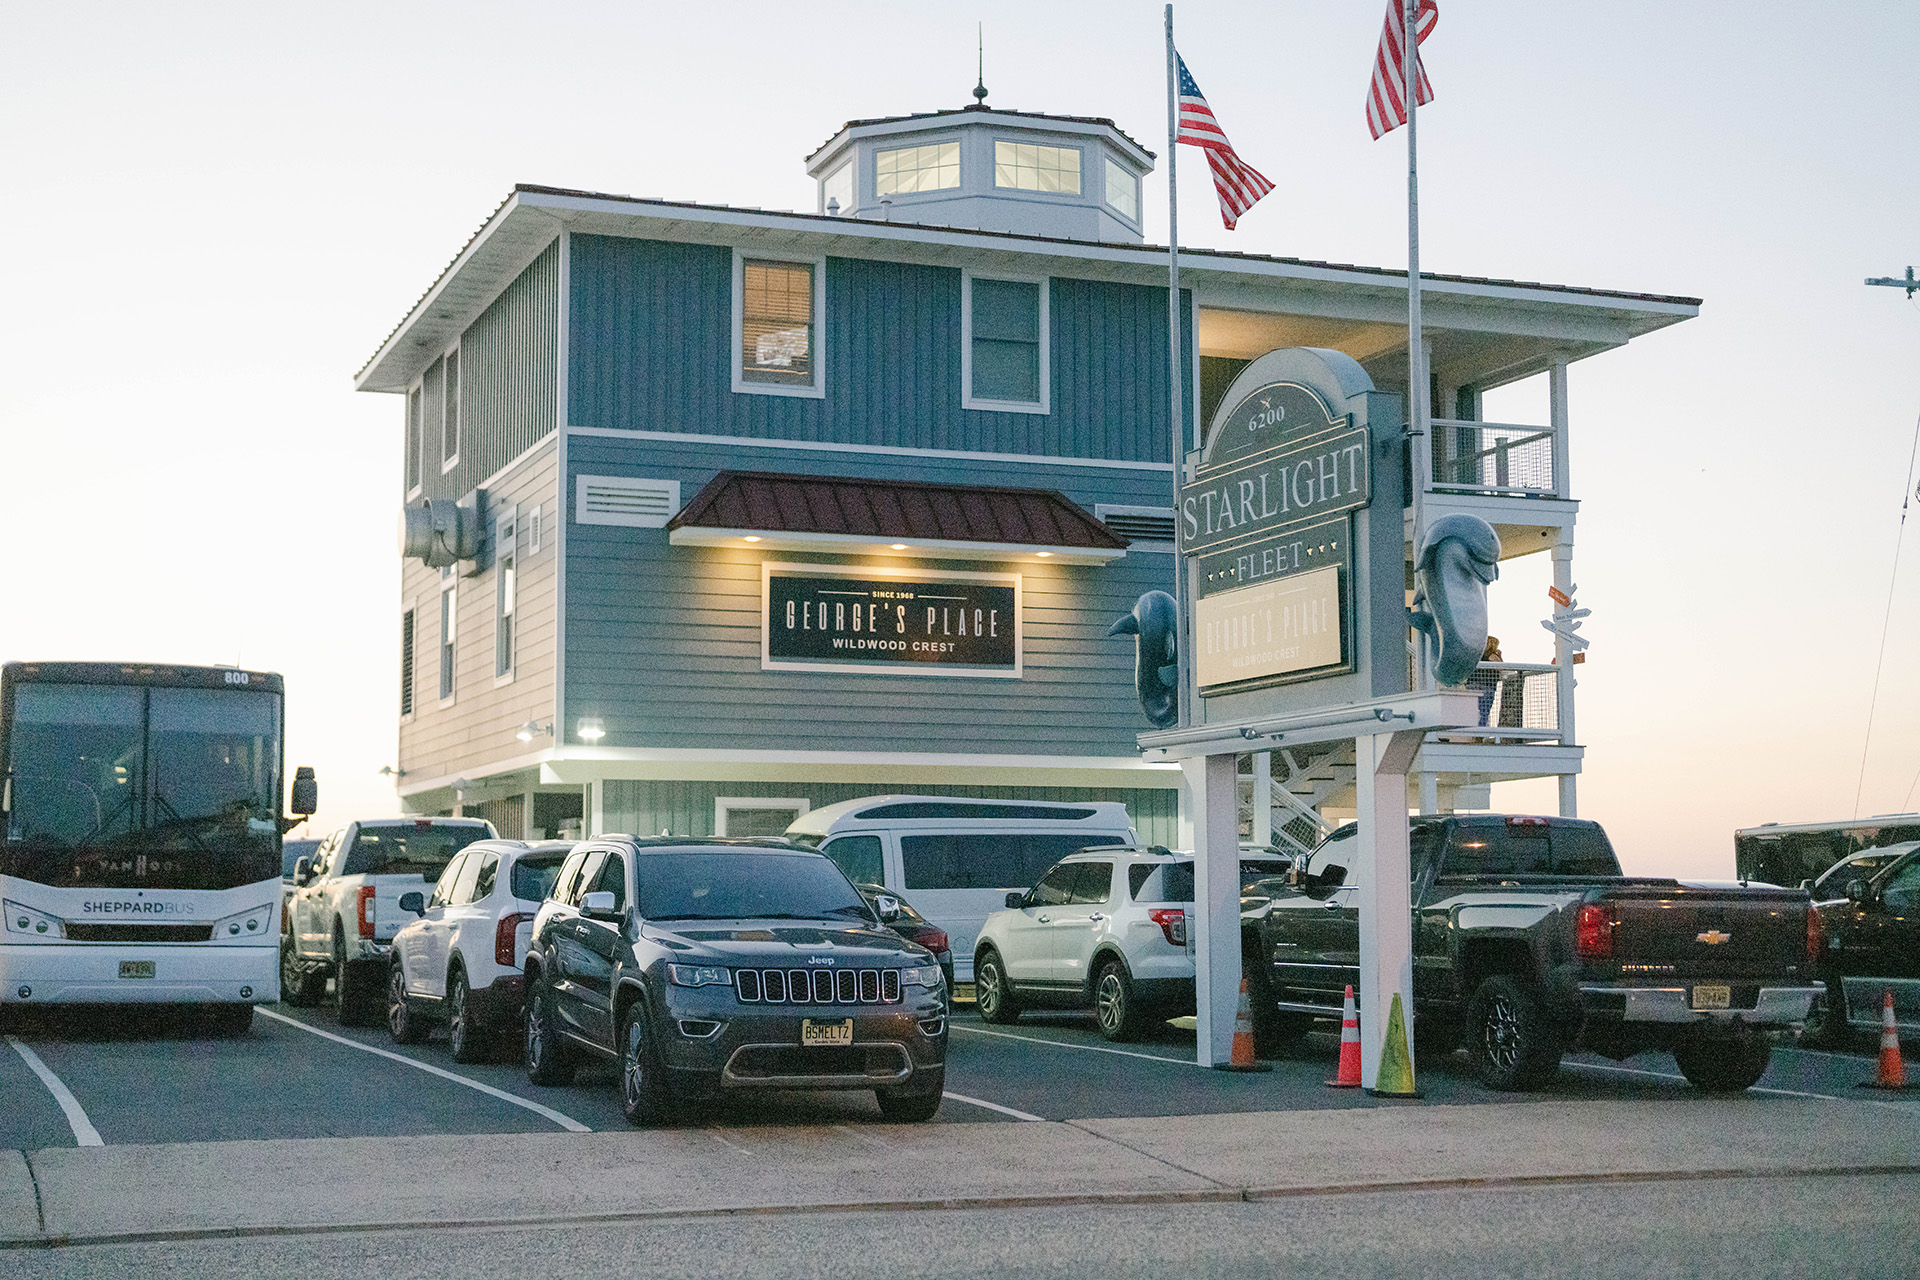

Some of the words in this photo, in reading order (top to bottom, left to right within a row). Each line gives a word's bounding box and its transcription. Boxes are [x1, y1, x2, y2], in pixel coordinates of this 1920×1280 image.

[1248, 406, 1285, 431] 6200
[1183, 443, 1363, 541] STARLIGHT
[1237, 541, 1303, 582] FLEET
[872, 591, 895, 599] SINCE
[786, 600, 905, 634] GEORGE'S
[927, 606, 998, 637] PLACE
[1207, 609, 1272, 655] GEORGE'S
[1283, 598, 1328, 640] PLACE
[832, 638, 907, 651] WILDWOOD
[912, 641, 956, 653] CREST
[1232, 651, 1273, 668] WILDWOOD
[1274, 646, 1301, 661] CREST
[225, 671, 249, 684] 800
[808, 956, 835, 966] Jeep
